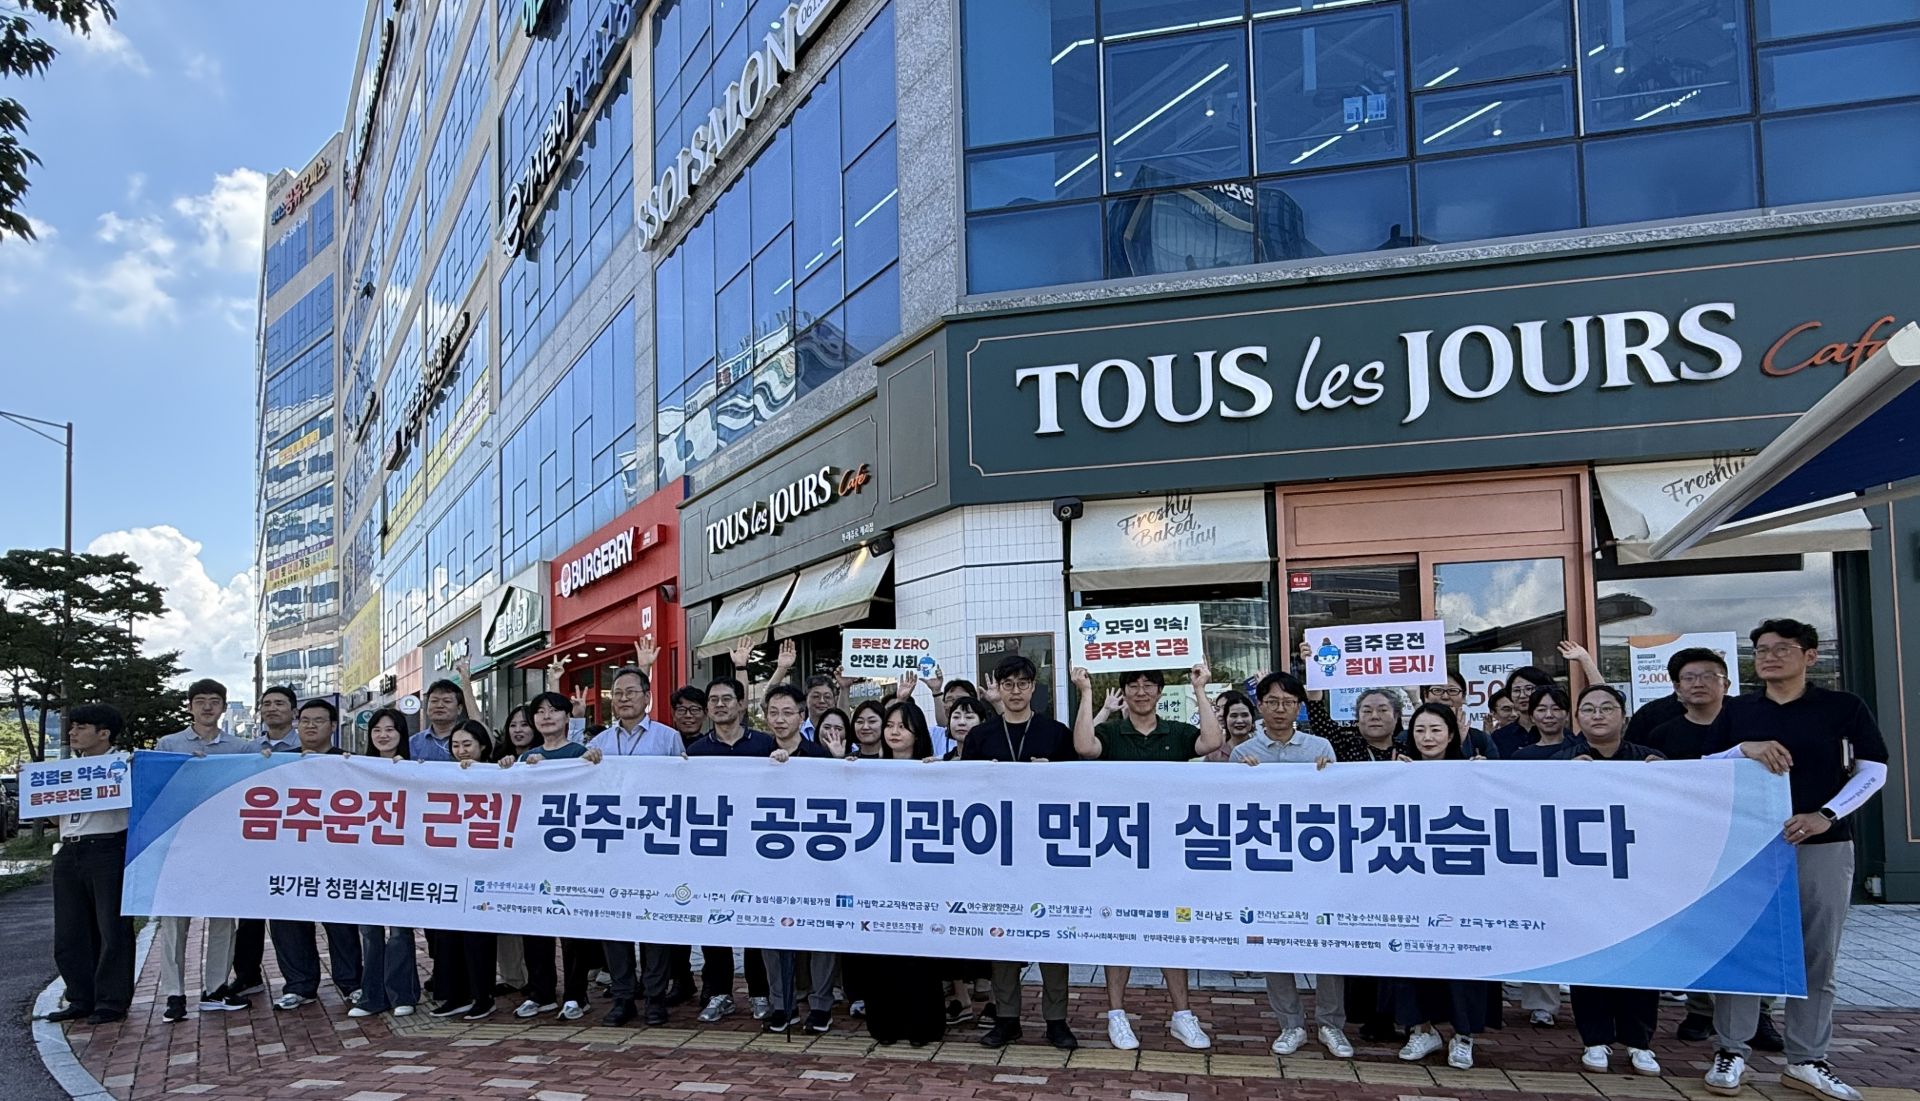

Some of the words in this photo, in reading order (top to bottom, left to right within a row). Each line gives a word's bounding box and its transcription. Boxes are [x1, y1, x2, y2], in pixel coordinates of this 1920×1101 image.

[691, 3, 800, 186] SALON
[1015, 346, 1273, 435] TOUS
[1295, 336, 1385, 411] les
[1399, 302, 1744, 425] JOURS
[1761, 314, 1898, 377] Caf
[706, 507, 750, 554] TOUS
[750, 501, 768, 535] les
[769, 465, 832, 535] JOURS
[1117, 487, 1193, 536] Freshly
[571, 526, 635, 590] BURGERRY
[1105, 617, 1149, 635] 모두의
[1152, 614, 1189, 632] 약속!
[851, 638, 891, 651] 음주운전
[894, 638, 930, 651] ZERO
[1084, 639, 1151, 661] 음주운전
[1155, 637, 1190, 657] 근절
[1344, 631, 1425, 654] 음주운전
[850, 654, 888, 669] 안전한
[892, 653, 919, 669] 사회
[1345, 656, 1383, 676] 절대
[1388, 654, 1435, 674] 금지!
[1478, 663, 1514, 675] 현대카드
[30, 769, 72, 787] 청렴은
[77, 765, 107, 781] 약속
[30, 786, 92, 806] 음주운전은
[96, 784, 120, 799] 파괴
[239, 785, 407, 849] 음주운전
[421, 791, 522, 850] 근절!
[537, 793, 735, 858] 광주·전남
[750, 796, 1014, 866] 공공기관이
[1038, 802, 1150, 869] 먼저
[1174, 803, 1636, 880] 실천하겠습니다
[268, 875, 321, 897] 빛가람
[325, 877, 459, 904] 청렴실천네트워크
[546, 906, 566, 915] KCA
[856, 899, 939, 911] 사립학교교직원연금공단
[1195, 910, 1233, 921] 전라남도
[1316, 913, 1334, 925] aT
[1460, 917, 1546, 930] 한국농어촌공사
[949, 926, 983, 936] 한전KDN
[1057, 930, 1076, 939] SSN
